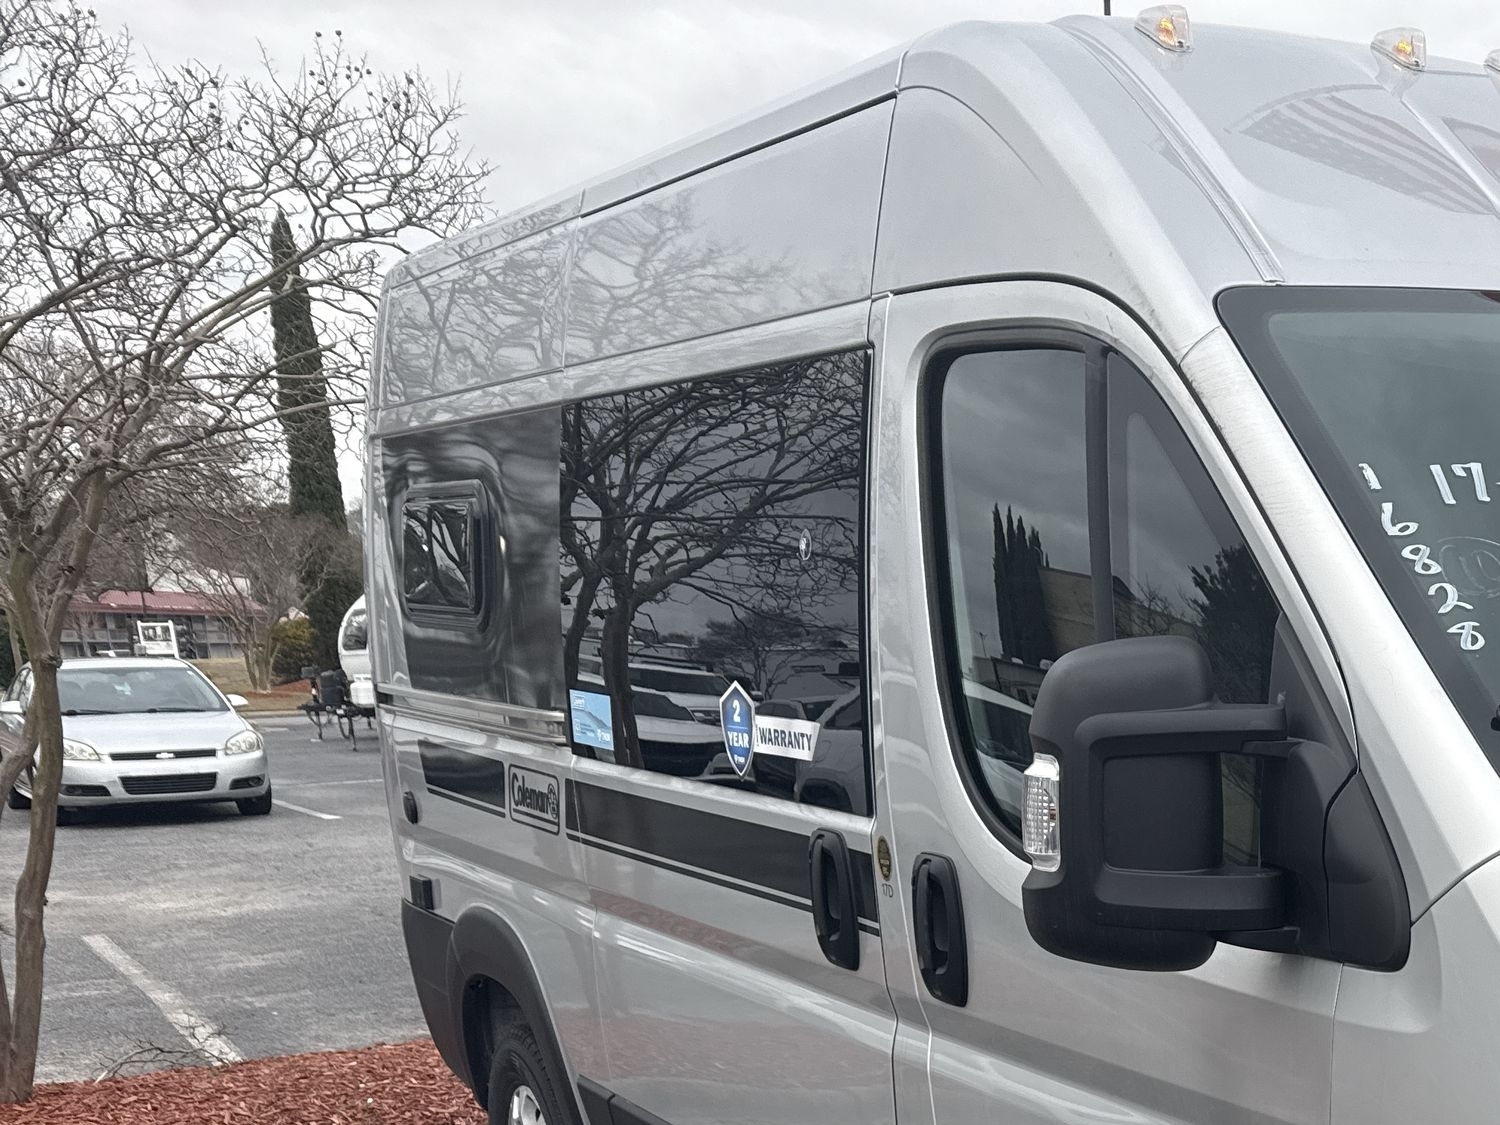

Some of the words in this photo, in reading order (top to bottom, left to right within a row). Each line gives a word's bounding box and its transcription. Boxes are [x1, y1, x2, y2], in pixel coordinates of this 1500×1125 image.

[732, 699, 742, 723] 2
[727, 730, 750, 749] YEAR
[758, 726, 812, 752] WARRANTY
[511, 772, 549, 815] Coleman
